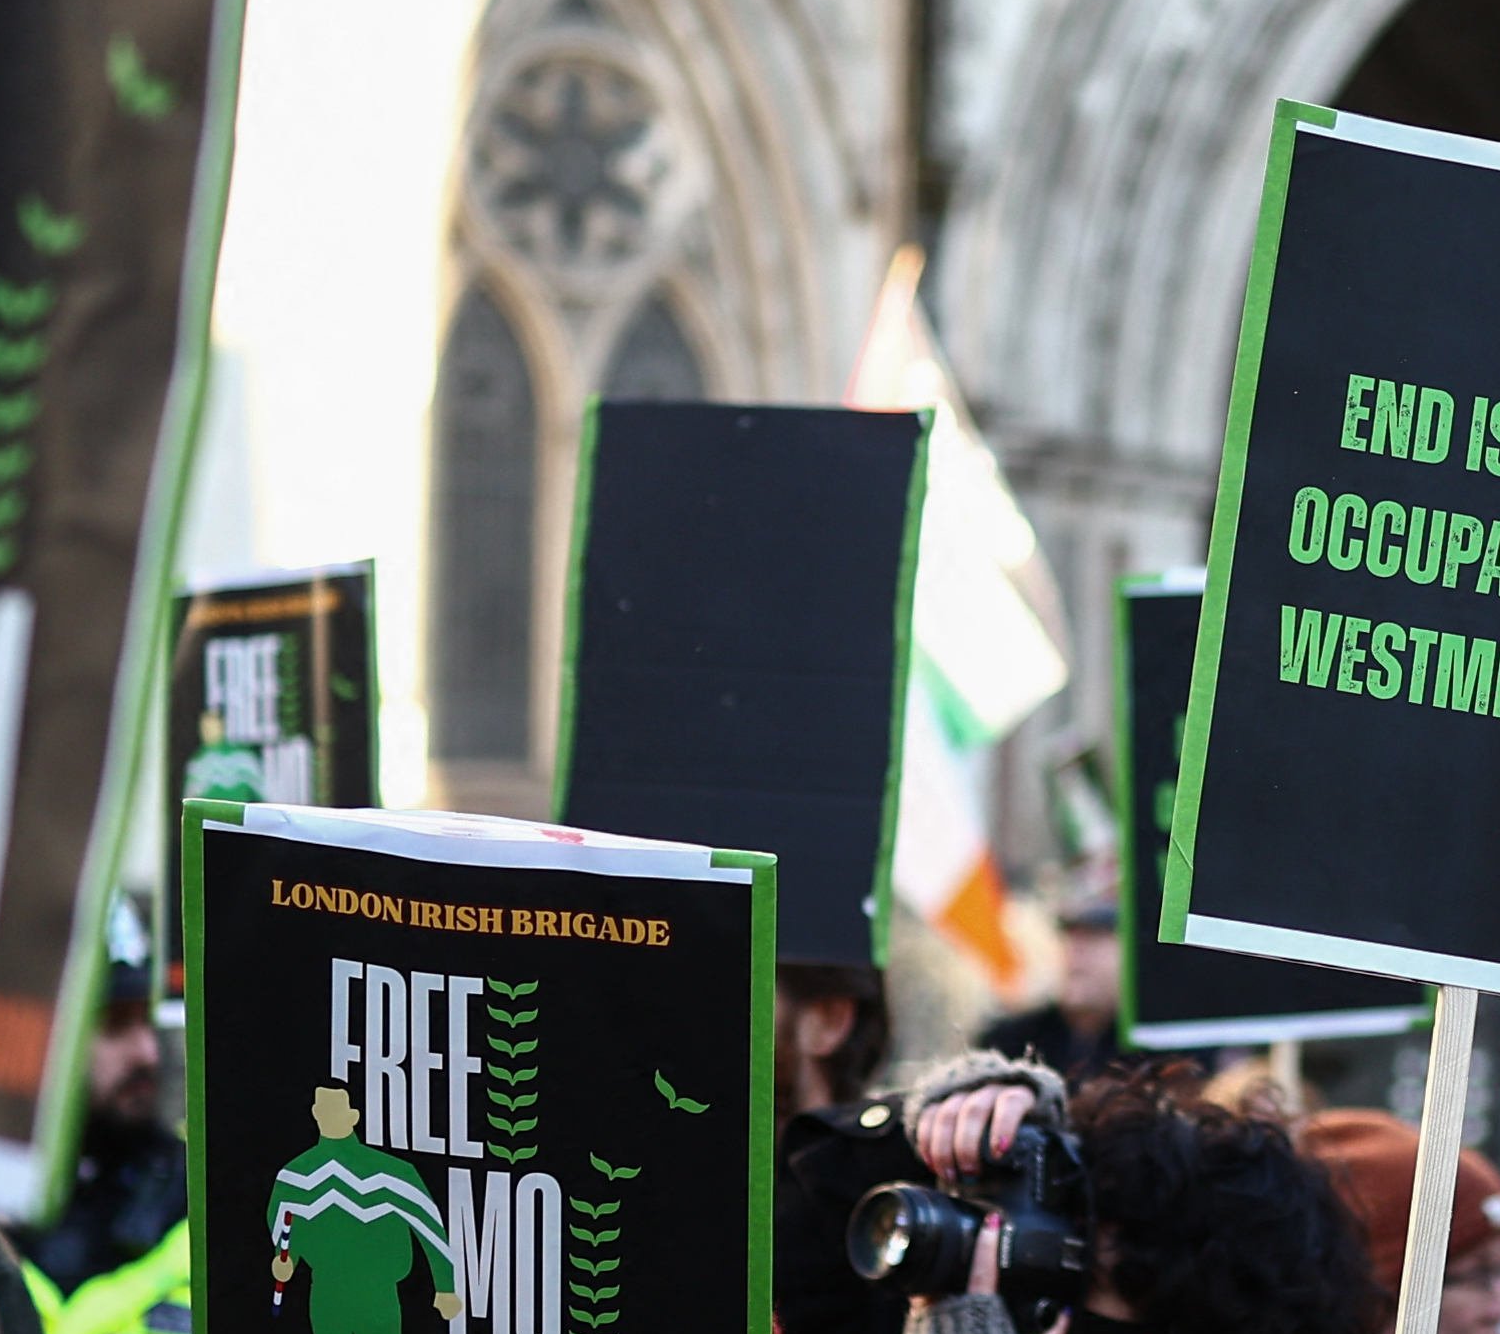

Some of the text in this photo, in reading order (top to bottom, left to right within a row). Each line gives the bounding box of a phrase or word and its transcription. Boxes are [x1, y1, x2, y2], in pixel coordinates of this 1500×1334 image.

[1339, 373, 1455, 466] END
[272, 879, 671, 947] LONDON IRISH BRIGADE
[331, 957, 484, 1159] FREE
